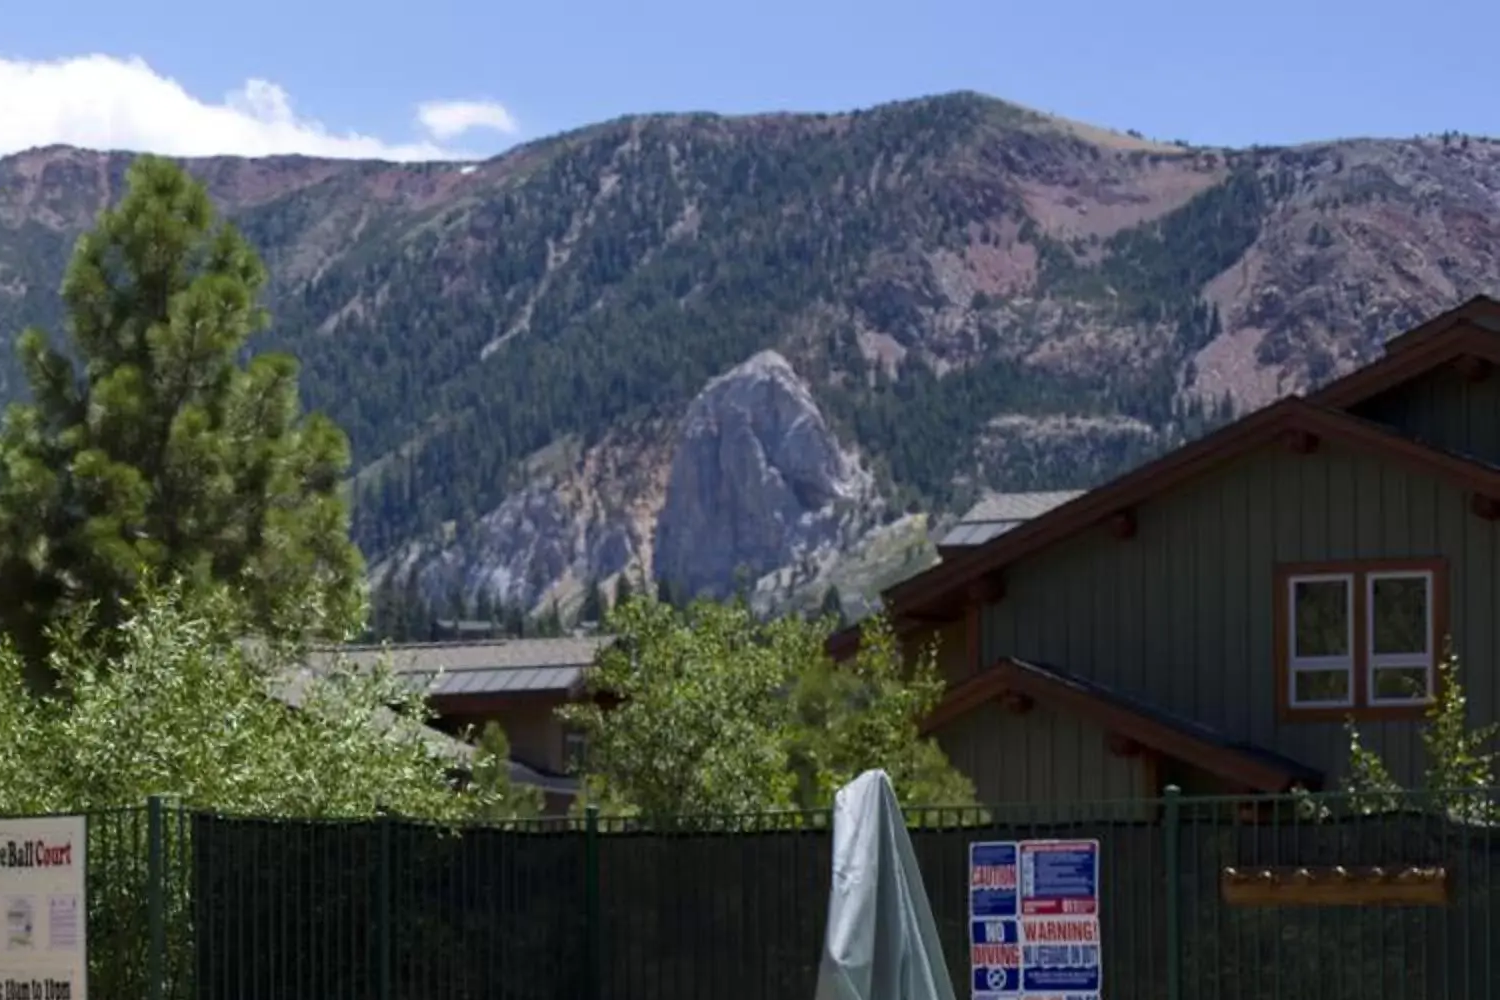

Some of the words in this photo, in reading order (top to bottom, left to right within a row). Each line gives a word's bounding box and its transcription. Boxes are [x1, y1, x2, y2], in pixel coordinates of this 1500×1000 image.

[7, 840, 34, 867] Ball
[35, 839, 72, 866] Court
[972, 864, 1016, 888] CAUTION
[985, 921, 1005, 942] NO
[1024, 920, 1098, 941] WARNING!
[974, 944, 1020, 965] DIVING
[32, 979, 42, 1000] to
